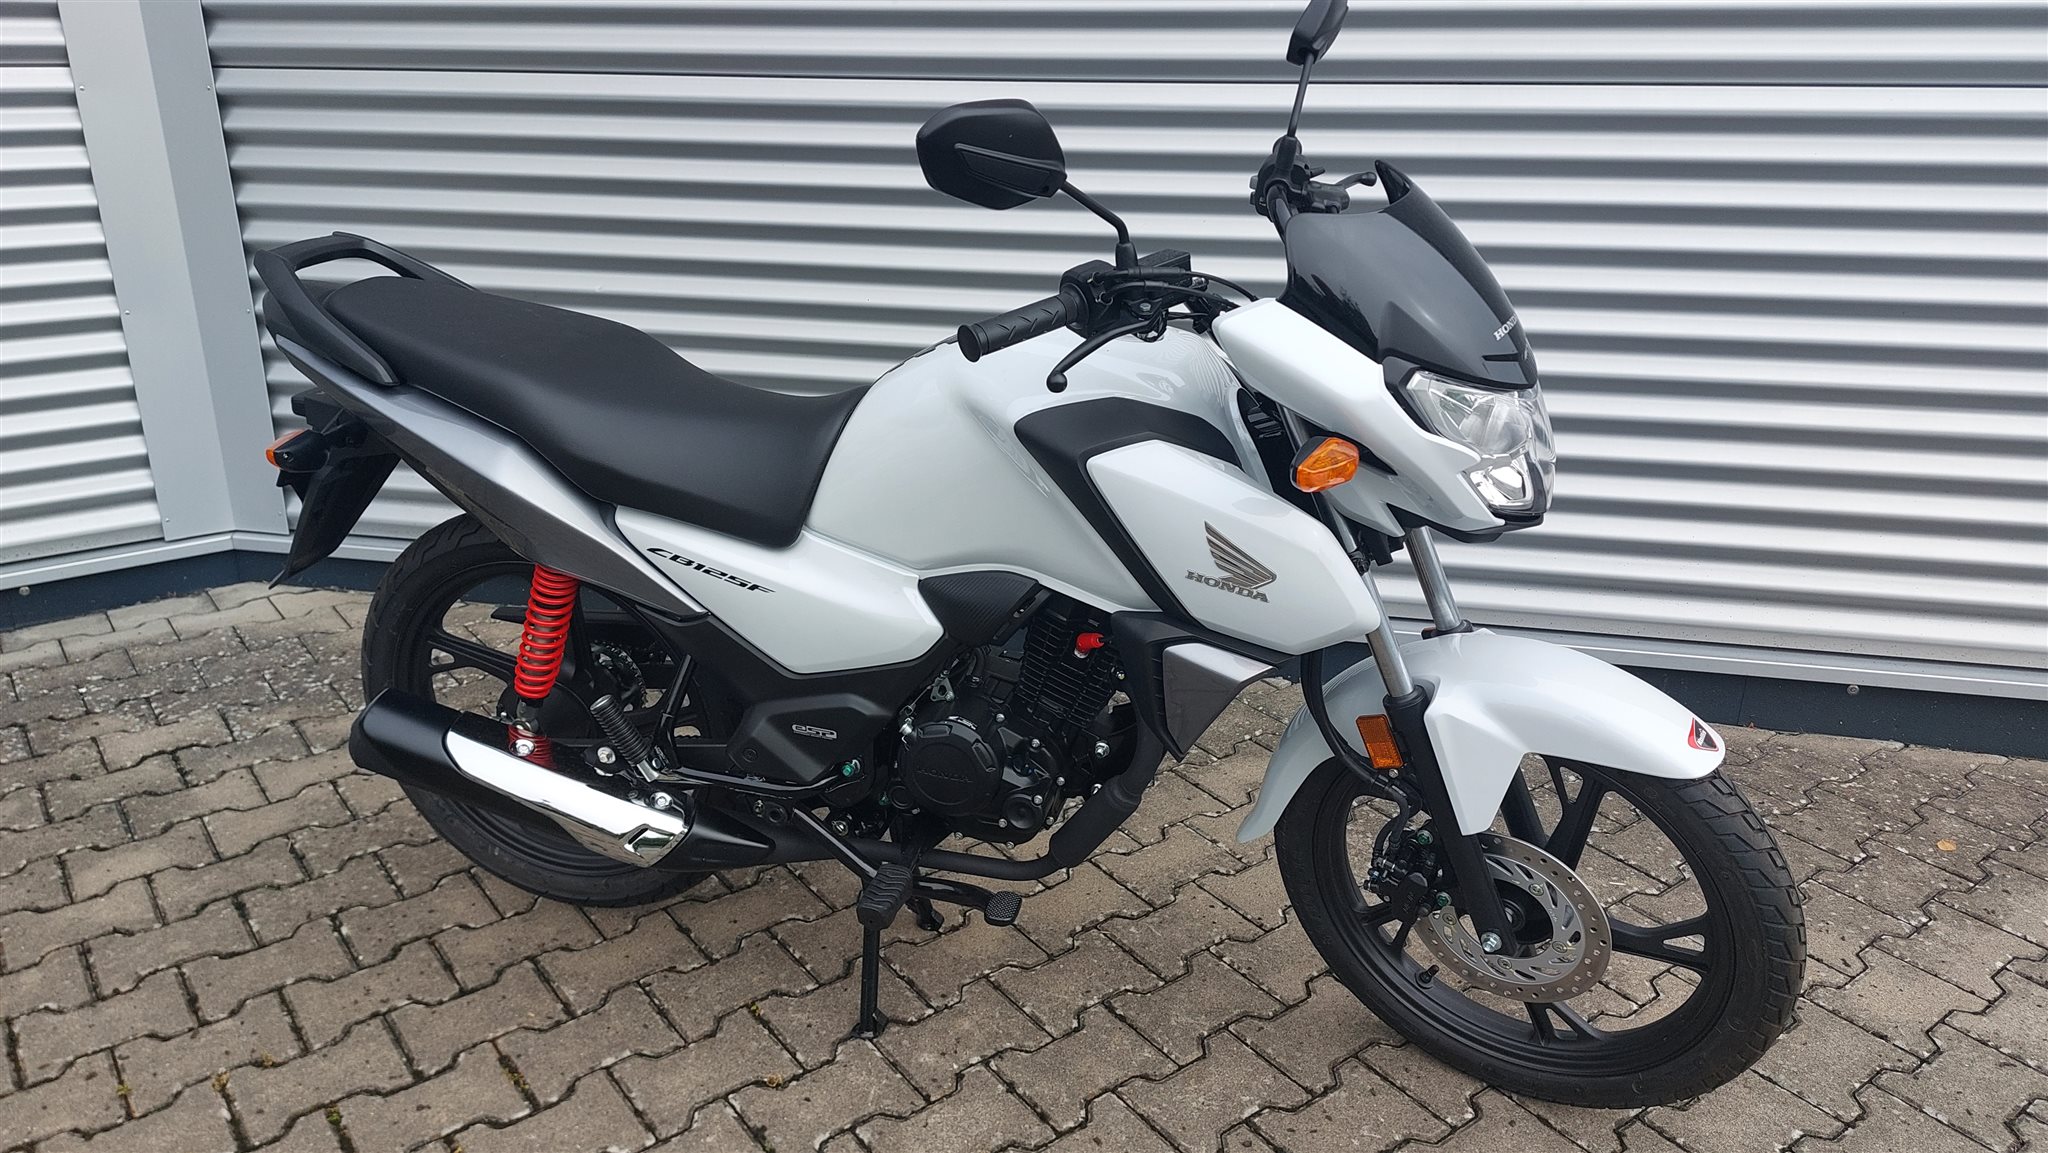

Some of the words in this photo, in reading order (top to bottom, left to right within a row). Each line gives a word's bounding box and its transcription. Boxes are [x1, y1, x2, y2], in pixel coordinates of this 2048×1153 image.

[1493, 313, 1518, 341] HOND
[646, 547, 776, 594] CB125F
[1184, 569, 1270, 603] HONDA
